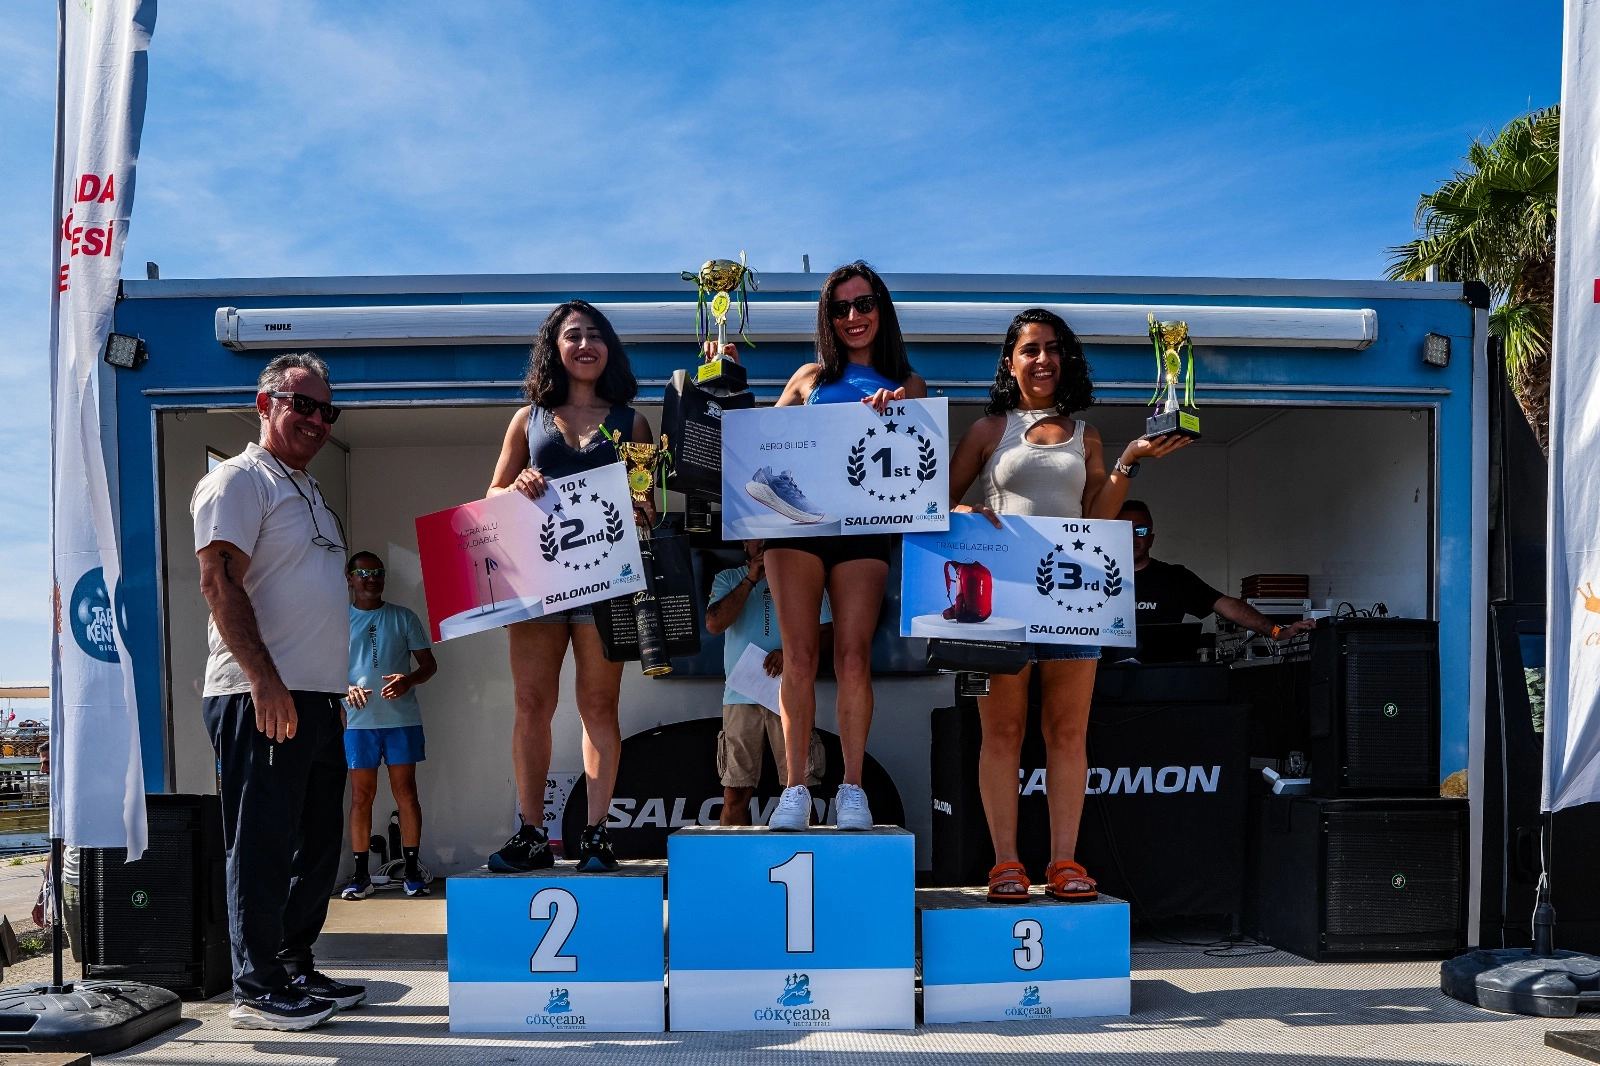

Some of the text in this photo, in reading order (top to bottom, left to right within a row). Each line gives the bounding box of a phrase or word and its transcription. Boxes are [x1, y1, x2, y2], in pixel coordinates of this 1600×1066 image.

[75, 174, 115, 204] DA
[897, 406, 906, 416] K
[760, 440, 817, 451] AERO GLIDE 3
[871, 447, 911, 478] 1st
[559, 478, 587, 493] 10 K
[482, 521, 498, 531] ALU
[844, 514, 914, 527] SALOMON
[1062, 523, 1091, 533] 10 K
[560, 518, 605, 551] 2nd
[995, 544, 1009, 552] 20
[1057, 562, 1100, 591] 3rd
[545, 580, 611, 605] SALOMON
[1136, 601, 1157, 610] ON
[86, 619, 113, 645] KEN
[1029, 624, 1100, 636] SALOMON
[1018, 766, 1220, 796] AOMON
[769, 852, 814, 953] 1
[530, 887, 579, 973] 2
[1013, 919, 1044, 971] 3
